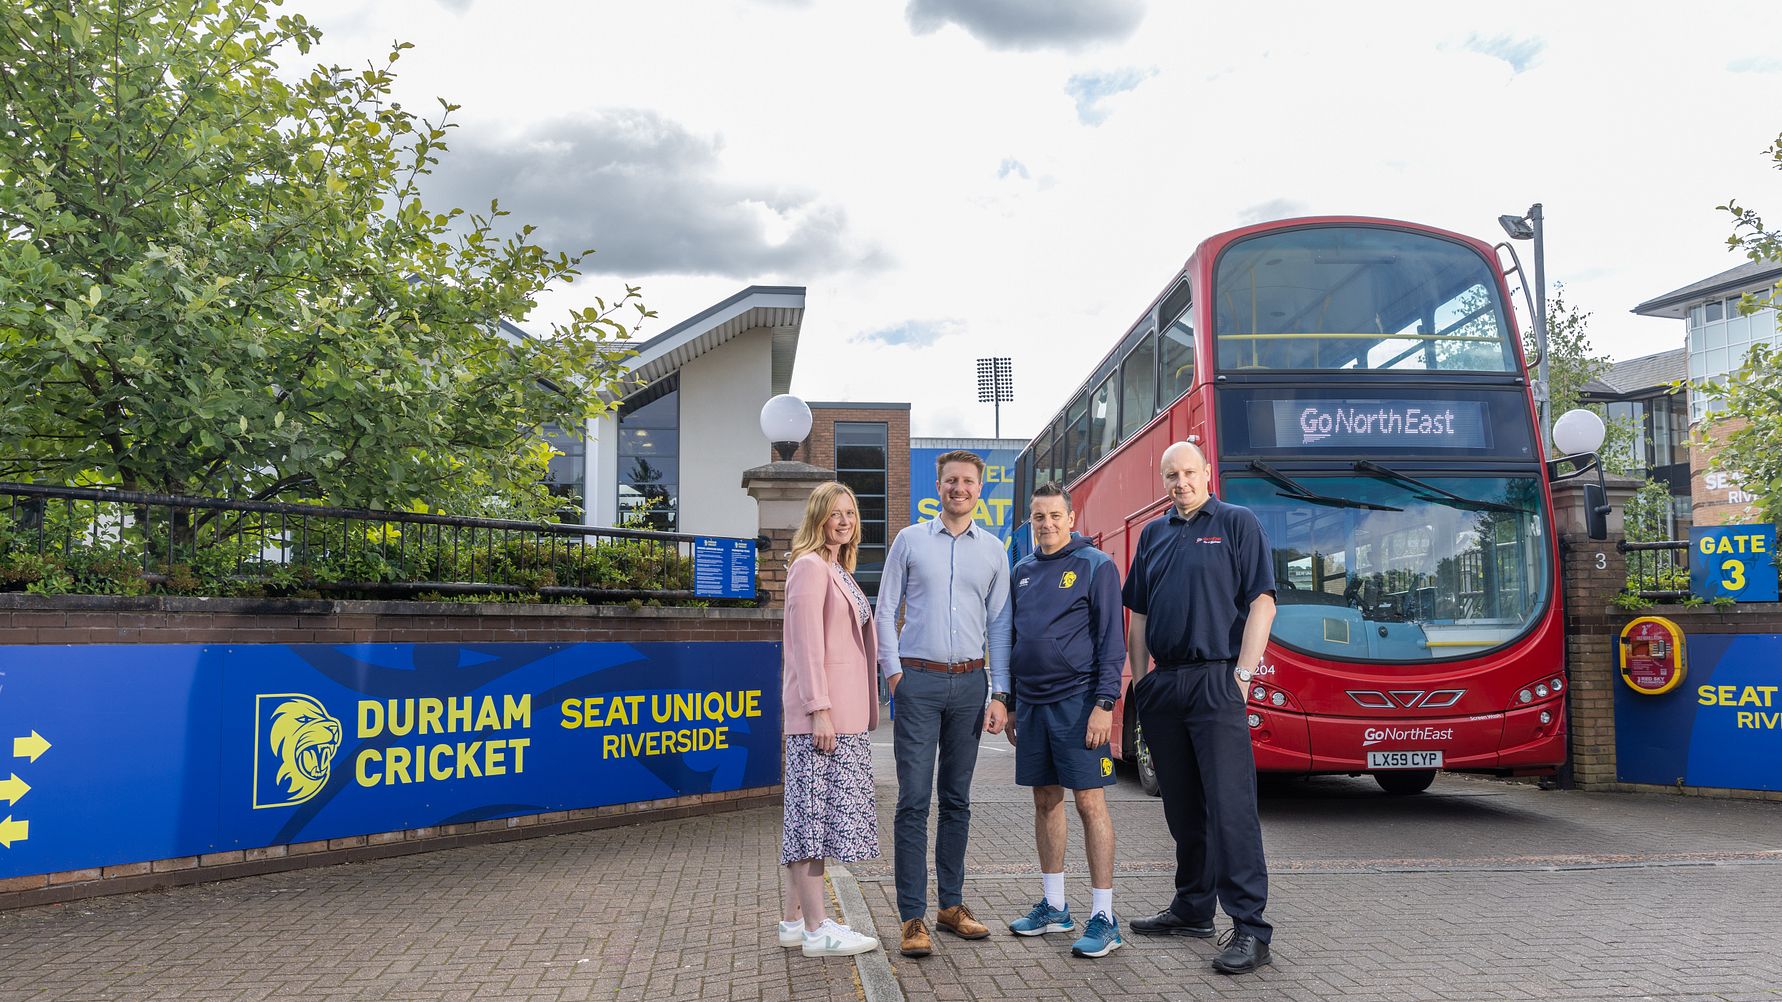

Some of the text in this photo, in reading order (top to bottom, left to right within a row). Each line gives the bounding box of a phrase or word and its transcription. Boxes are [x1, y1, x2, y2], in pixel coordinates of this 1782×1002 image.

[917, 498, 1013, 526] SAT
[1699, 534, 1766, 555] GATE
[1595, 552, 1607, 570] 3
[1721, 559, 1746, 592] 3
[560, 689, 762, 729] SEAT UNIQUE
[1697, 684, 1779, 707] SEAT
[357, 693, 532, 739] DURHAM
[1736, 711, 1782, 730] RIV
[603, 726, 730, 760] RIVERSIDE
[355, 738, 531, 788] CRICKET
[1372, 752, 1437, 767] LX59 CYP
